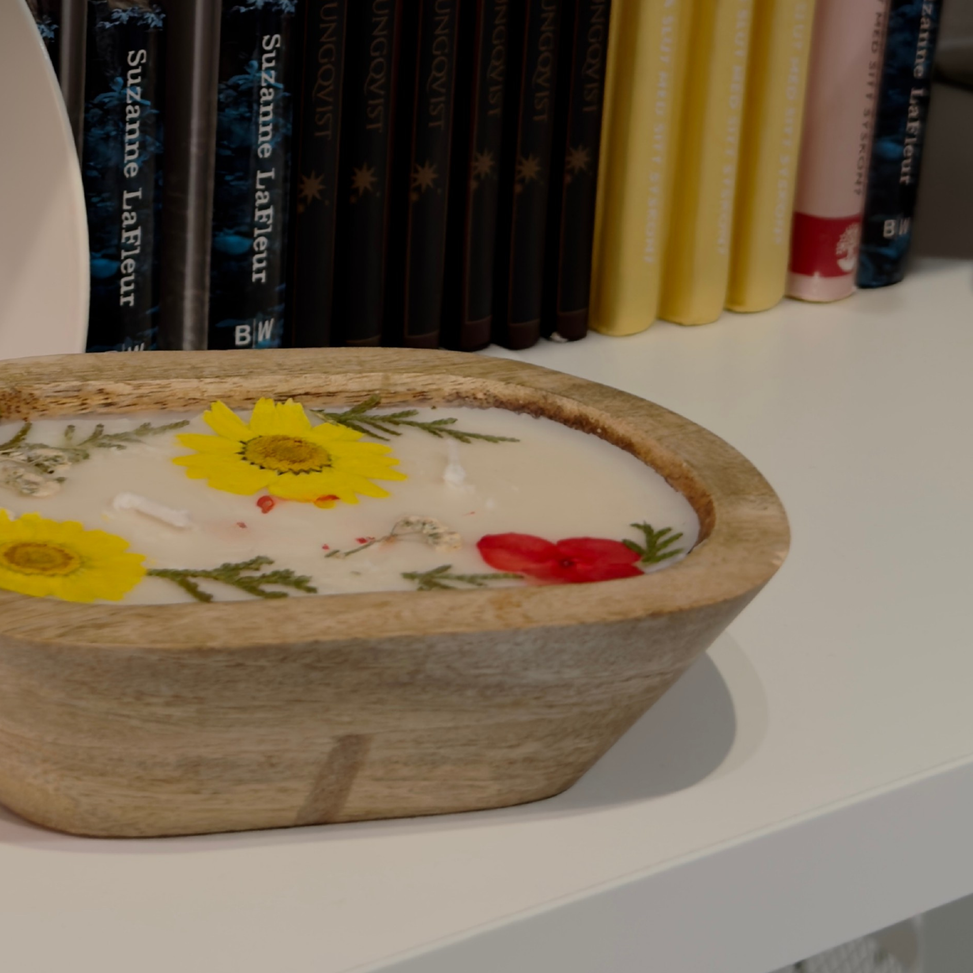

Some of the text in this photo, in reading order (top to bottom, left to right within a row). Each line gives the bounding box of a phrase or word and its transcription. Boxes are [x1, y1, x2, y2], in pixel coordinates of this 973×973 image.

[870, 12, 883, 54] MED
[119, 49, 147, 307] Suzanne LaFleur
[252, 34, 281, 284] Suzanne LaFleur
[899, 86, 926, 186] LaFleur
